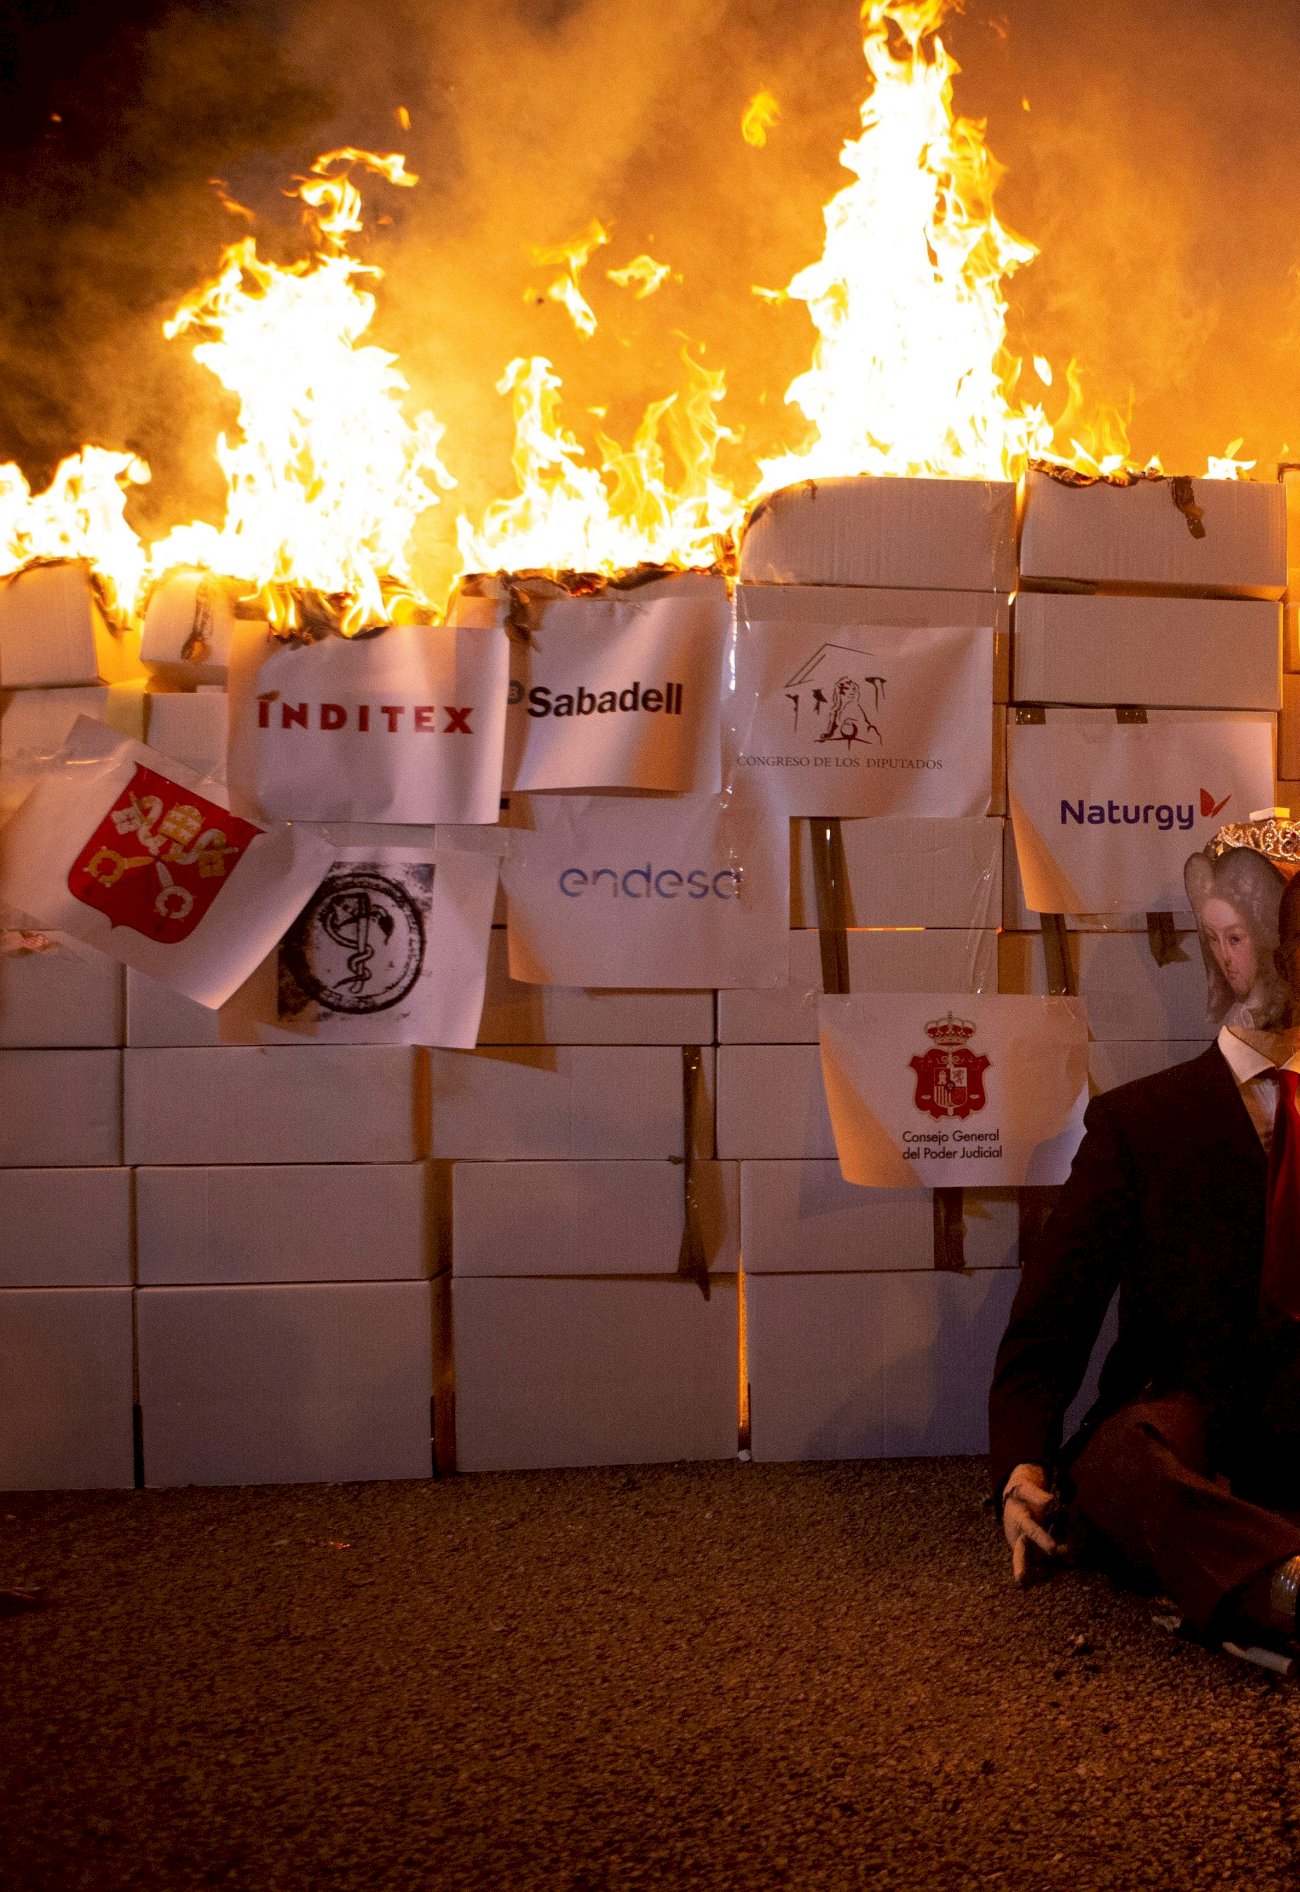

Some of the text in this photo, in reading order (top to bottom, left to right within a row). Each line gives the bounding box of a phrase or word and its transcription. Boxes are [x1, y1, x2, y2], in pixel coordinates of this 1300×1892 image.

[527, 681, 683, 718] Sabadell
[258, 700, 475, 734] INDITEX
[736, 755, 944, 770] CONGRESO DE LOS DIPUTADOS
[1060, 799, 1194, 831] Naturgy
[902, 1128, 1000, 1146] Consejo General
[902, 1145, 1003, 1160] del Poder Judicial
